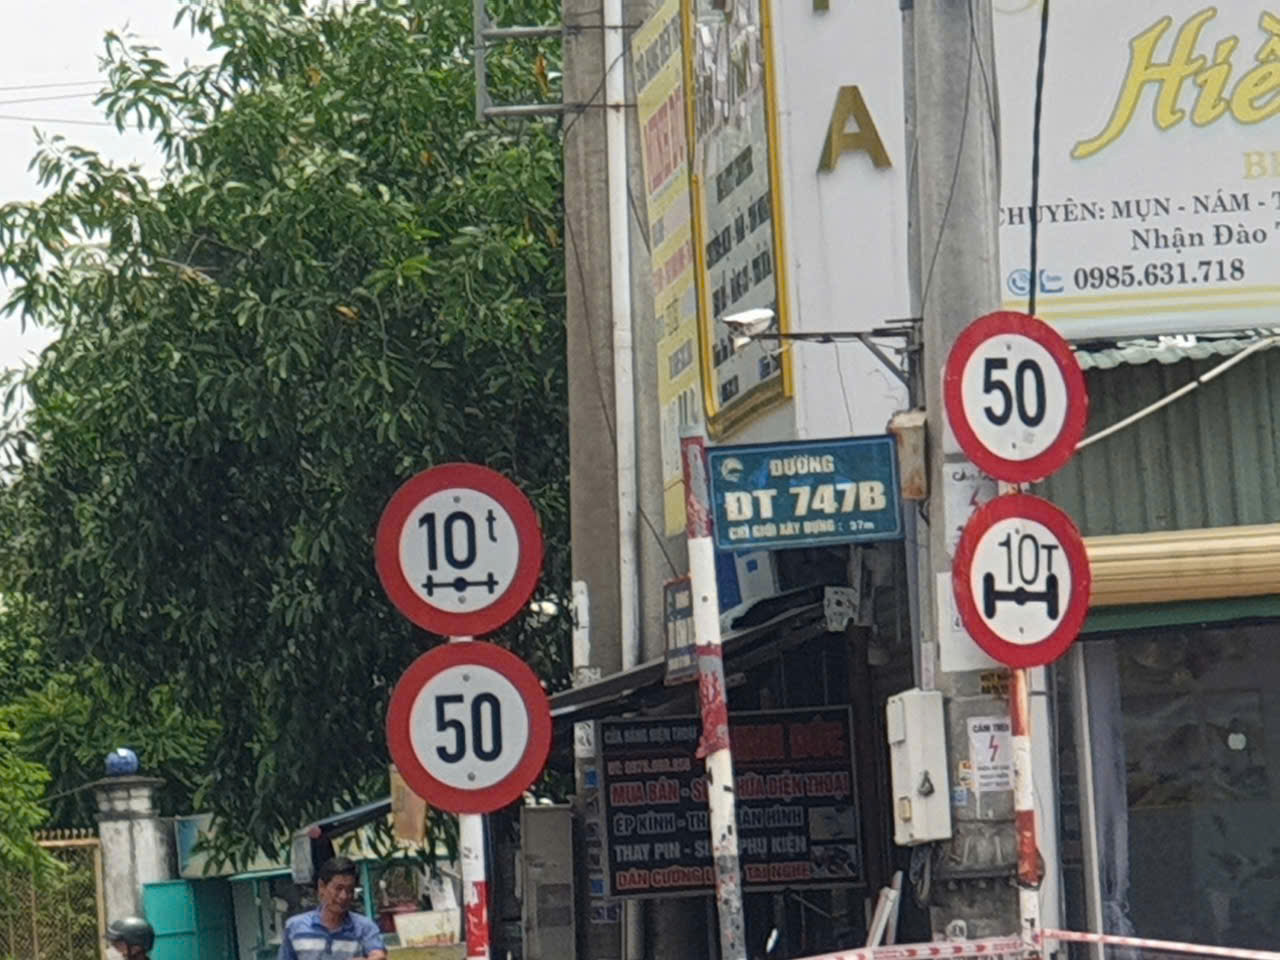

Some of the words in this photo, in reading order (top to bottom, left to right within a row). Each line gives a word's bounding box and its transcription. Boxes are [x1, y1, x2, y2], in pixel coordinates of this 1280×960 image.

[816, 84, 893, 172] A
[1111, 197, 1171, 223] MỤN
[1192, 188, 1251, 215] NÁM
[1131, 226, 1205, 255] Nhận
[1213, 222, 1268, 247] Đào
[1073, 257, 1246, 290] 0985.631.718
[983, 358, 1048, 428] 50
[724, 489, 778, 521] ĐT
[789, 480, 887, 517] 747B
[998, 532, 1060, 587] 10T
[434, 691, 504, 764] 50
